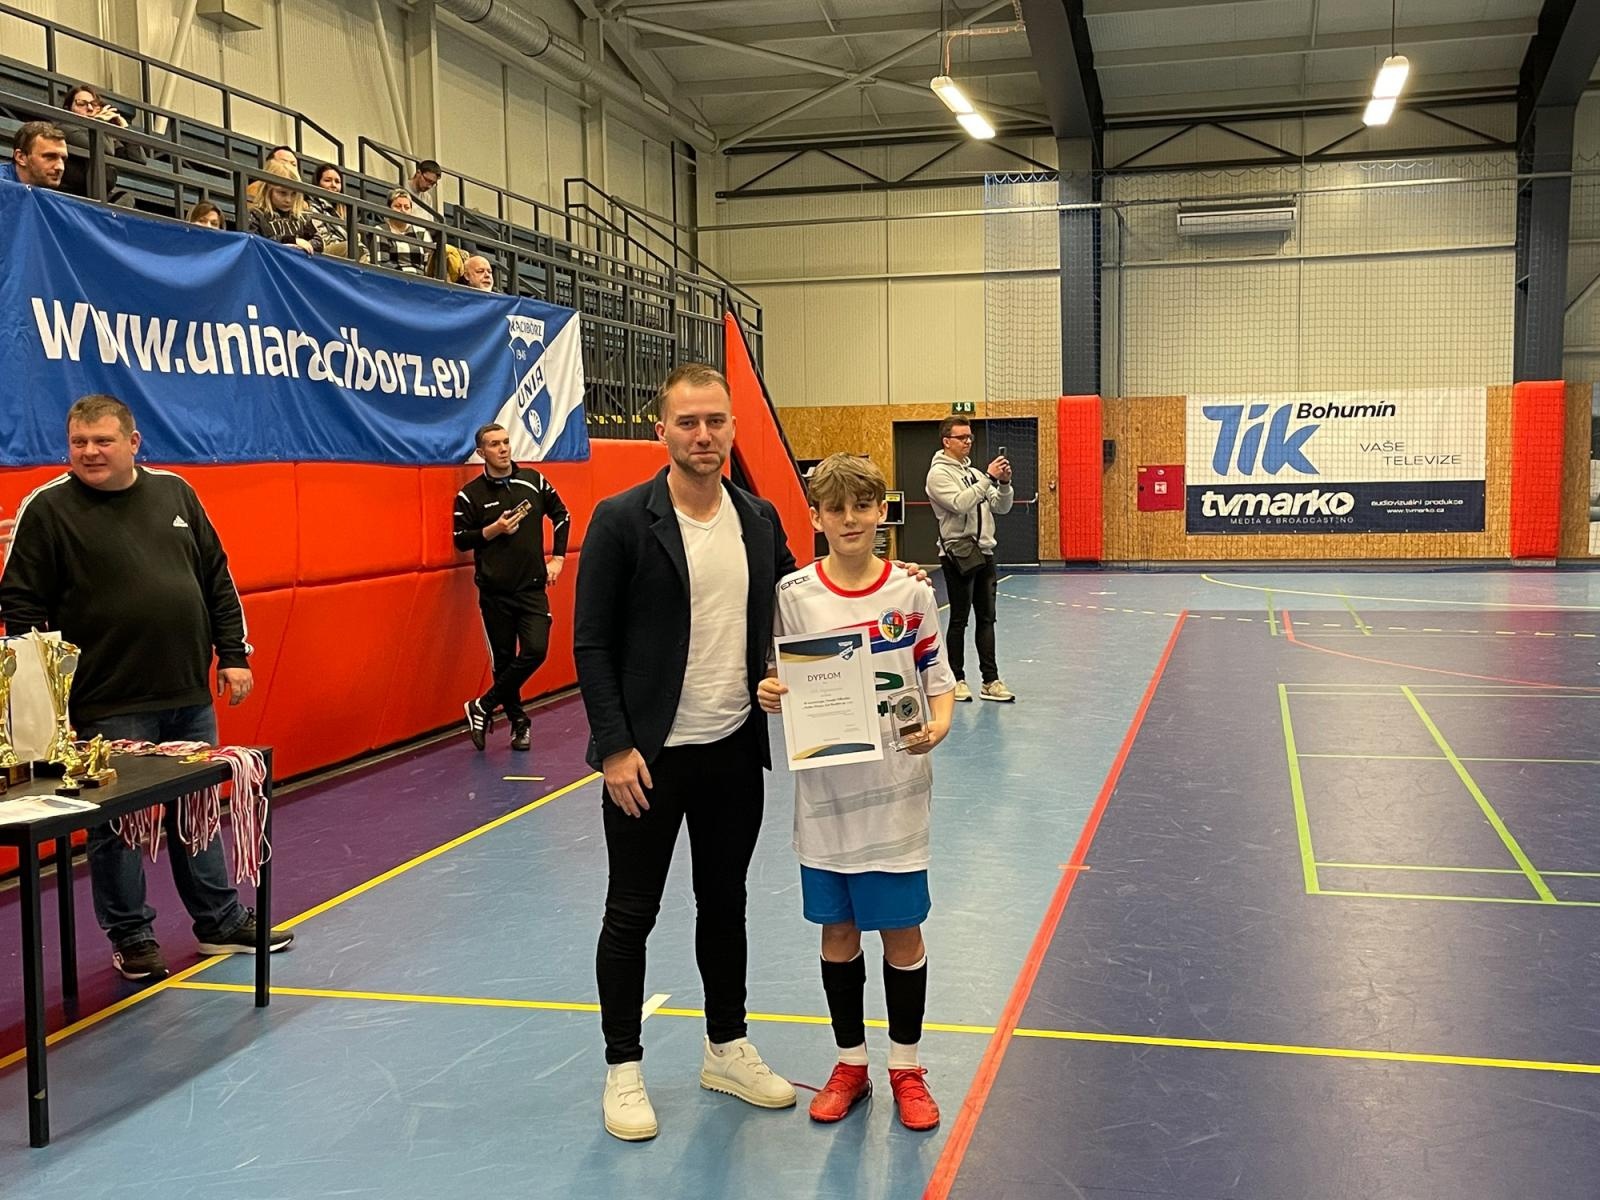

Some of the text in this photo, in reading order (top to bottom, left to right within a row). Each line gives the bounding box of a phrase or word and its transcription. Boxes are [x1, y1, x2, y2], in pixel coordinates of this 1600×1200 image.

[31, 297, 470, 400] www.uniaraciborz.eu
[518, 365, 544, 408] UNIA
[1296, 400, 1396, 419] Bohumín
[1203, 403, 1320, 476] Tik
[1360, 440, 1405, 452] VAŠE
[1383, 454, 1461, 466] TELEVIZE
[1201, 489, 1355, 517] tvmarko
[1424, 499, 1464, 507] produkce
[1230, 516, 1354, 525] MEDIA & BROADCASTING
[807, 671, 841, 682] DYPLOM
